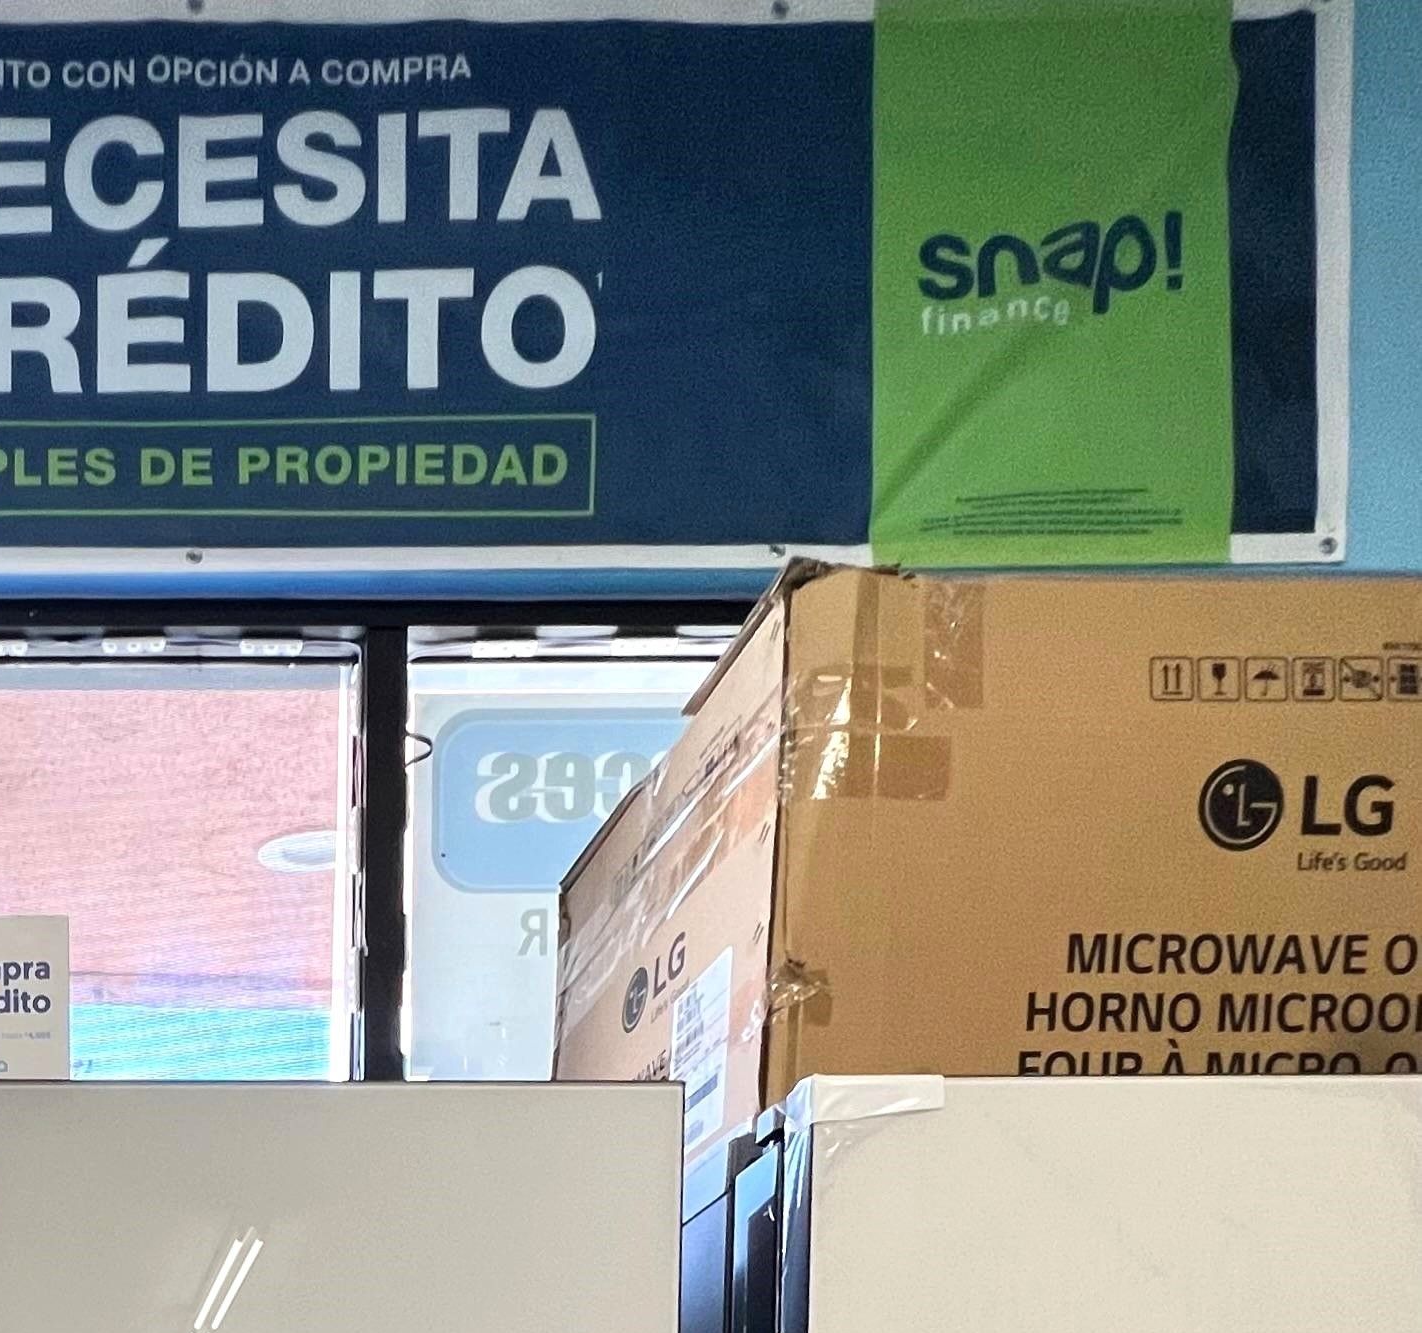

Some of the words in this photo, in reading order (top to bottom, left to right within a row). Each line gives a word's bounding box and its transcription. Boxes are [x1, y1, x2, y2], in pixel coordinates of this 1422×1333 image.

[62, 59, 135, 89] CON
[147, 54, 278, 88] OPCIÓN
[288, 57, 311, 86] A
[321, 54, 472, 86] COMPRA
[918, 211, 1183, 314] snap!
[921, 295, 1070, 335] finance
[140, 447, 213, 487] DE
[238, 444, 569, 486] PROPIEDAD
[1300, 774, 1395, 836] LG
[1297, 852, 1347, 872] Life's
[1354, 852, 1407, 872] Good
[652, 931, 687, 999] LG
[1066, 932, 1369, 975] MICROWAVE
[1385, 934, 1418, 976] O
[1025, 991, 1202, 1033] HORNO
